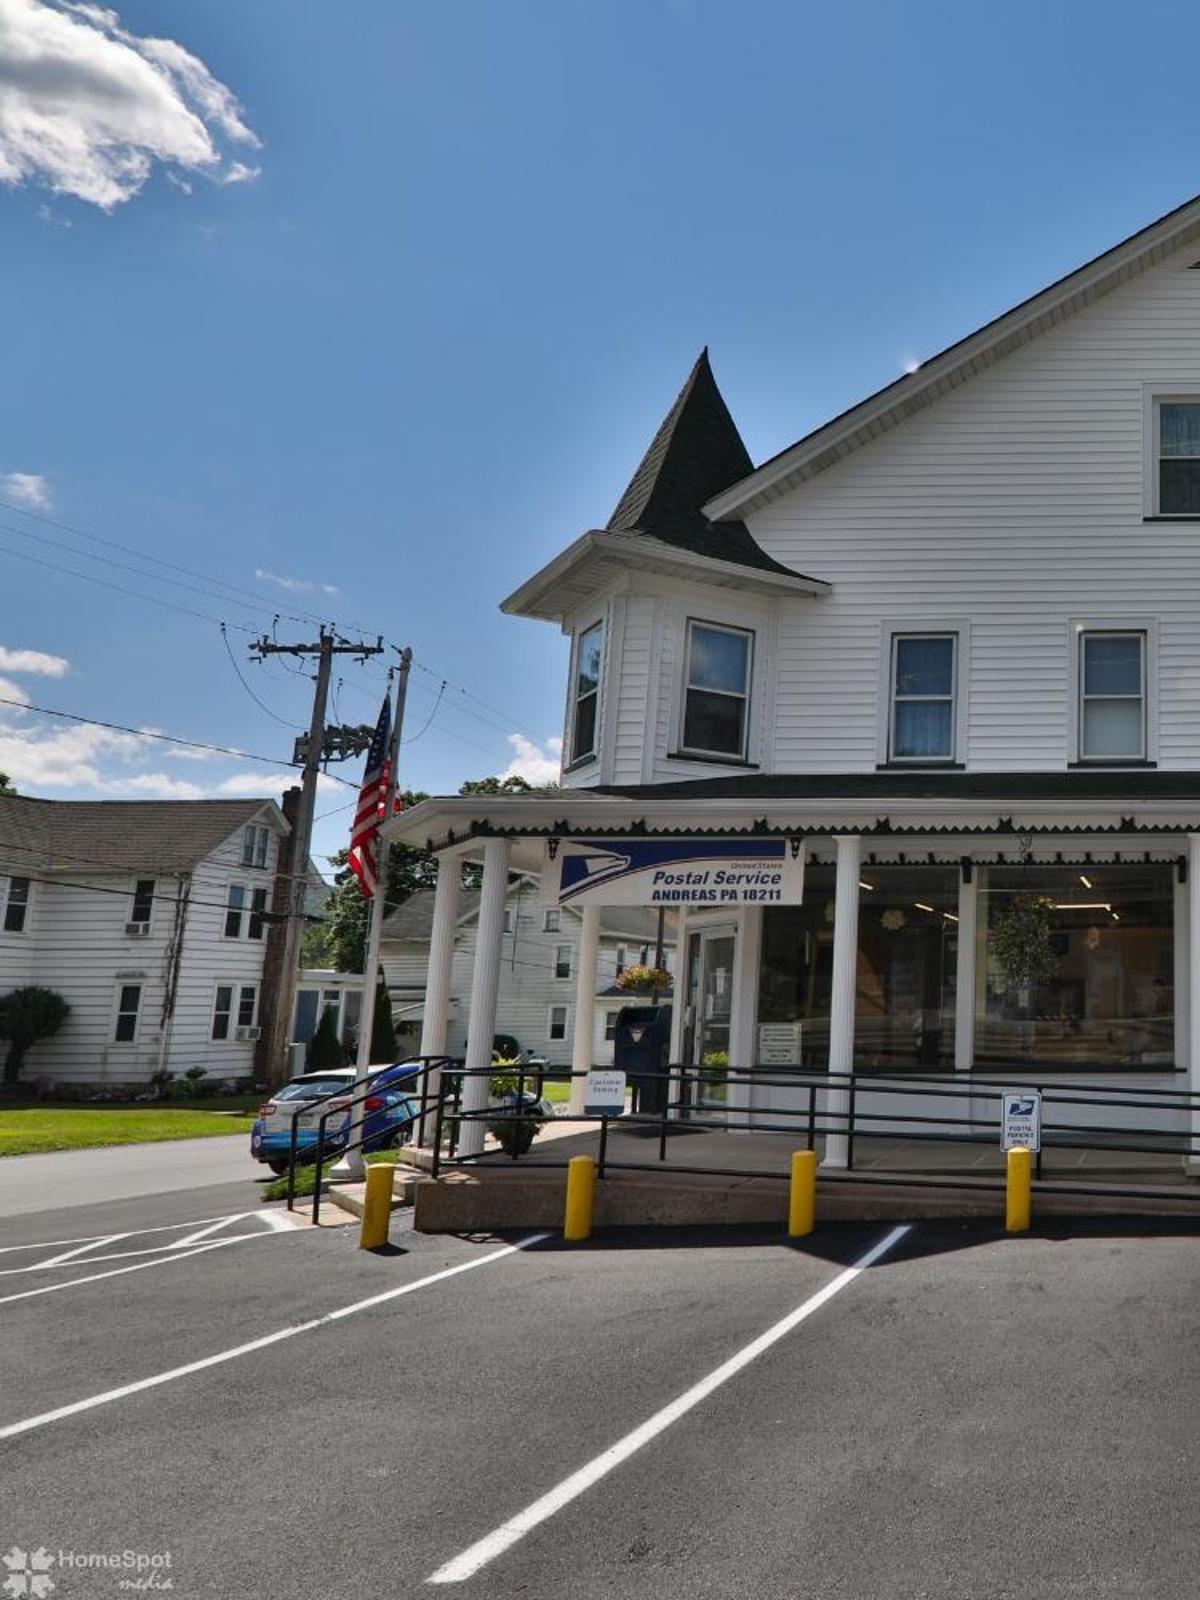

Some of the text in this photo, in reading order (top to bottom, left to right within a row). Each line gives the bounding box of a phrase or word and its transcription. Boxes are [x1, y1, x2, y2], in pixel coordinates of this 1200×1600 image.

[652, 870, 782, 885] Postal Service
[652, 889, 782, 901] ANDREAS PA 18211
